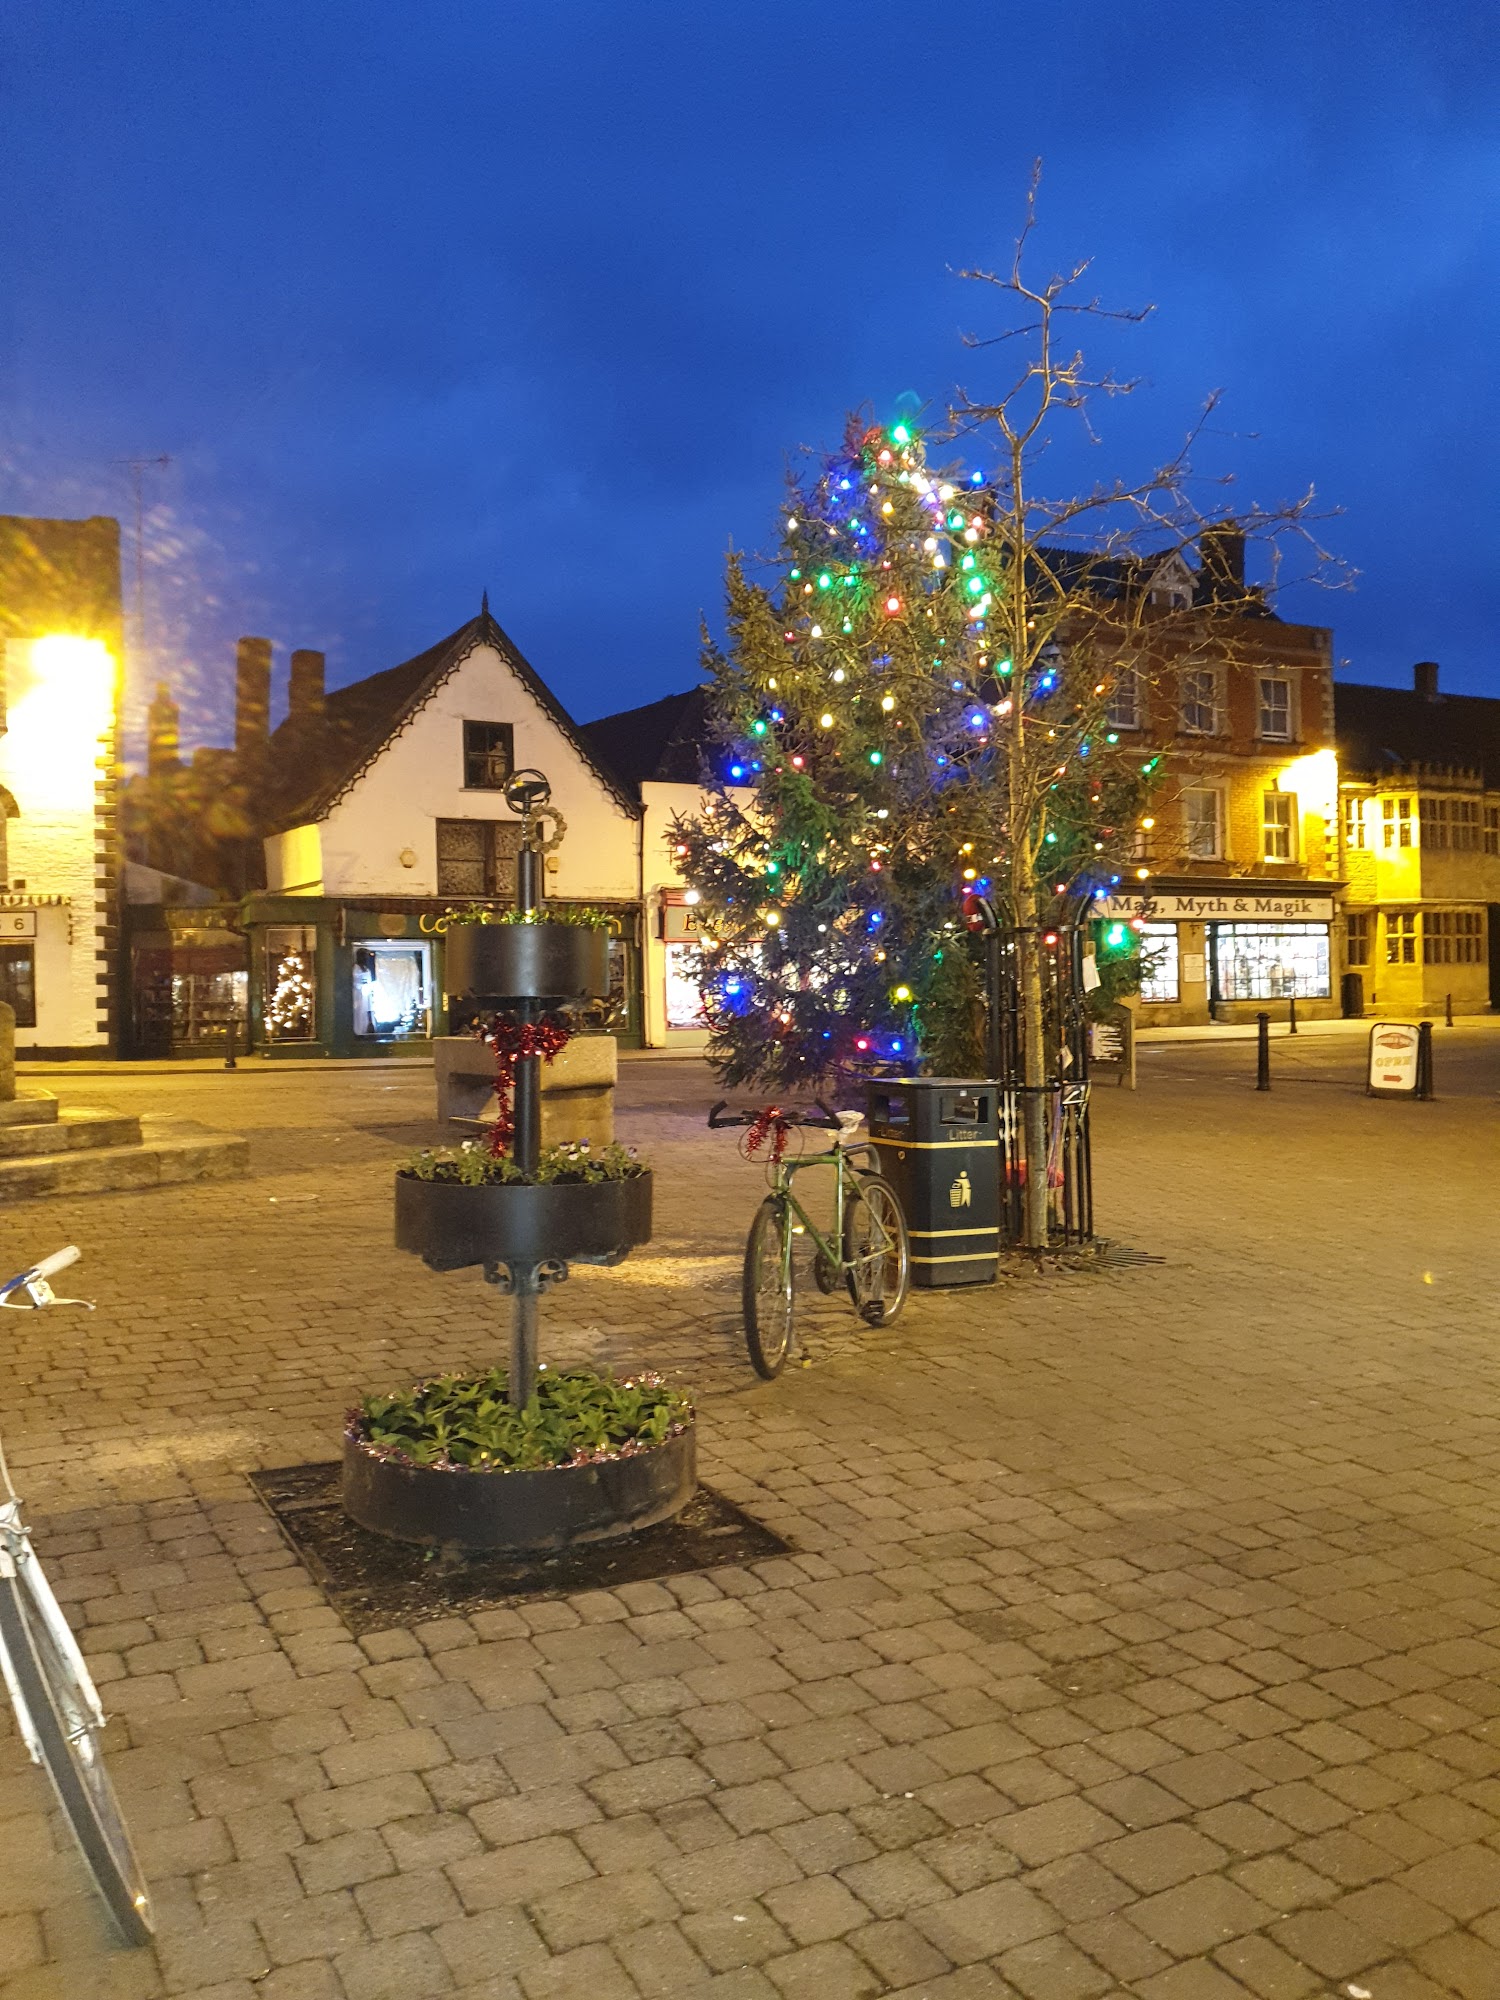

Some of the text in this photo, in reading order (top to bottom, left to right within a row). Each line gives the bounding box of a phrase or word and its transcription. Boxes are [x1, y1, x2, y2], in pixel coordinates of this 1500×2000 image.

[1176, 897, 1228, 916] Myth
[1233, 898, 1249, 912] &
[1255, 898, 1313, 916] Magik
[948, 1129, 979, 1141] Litter
